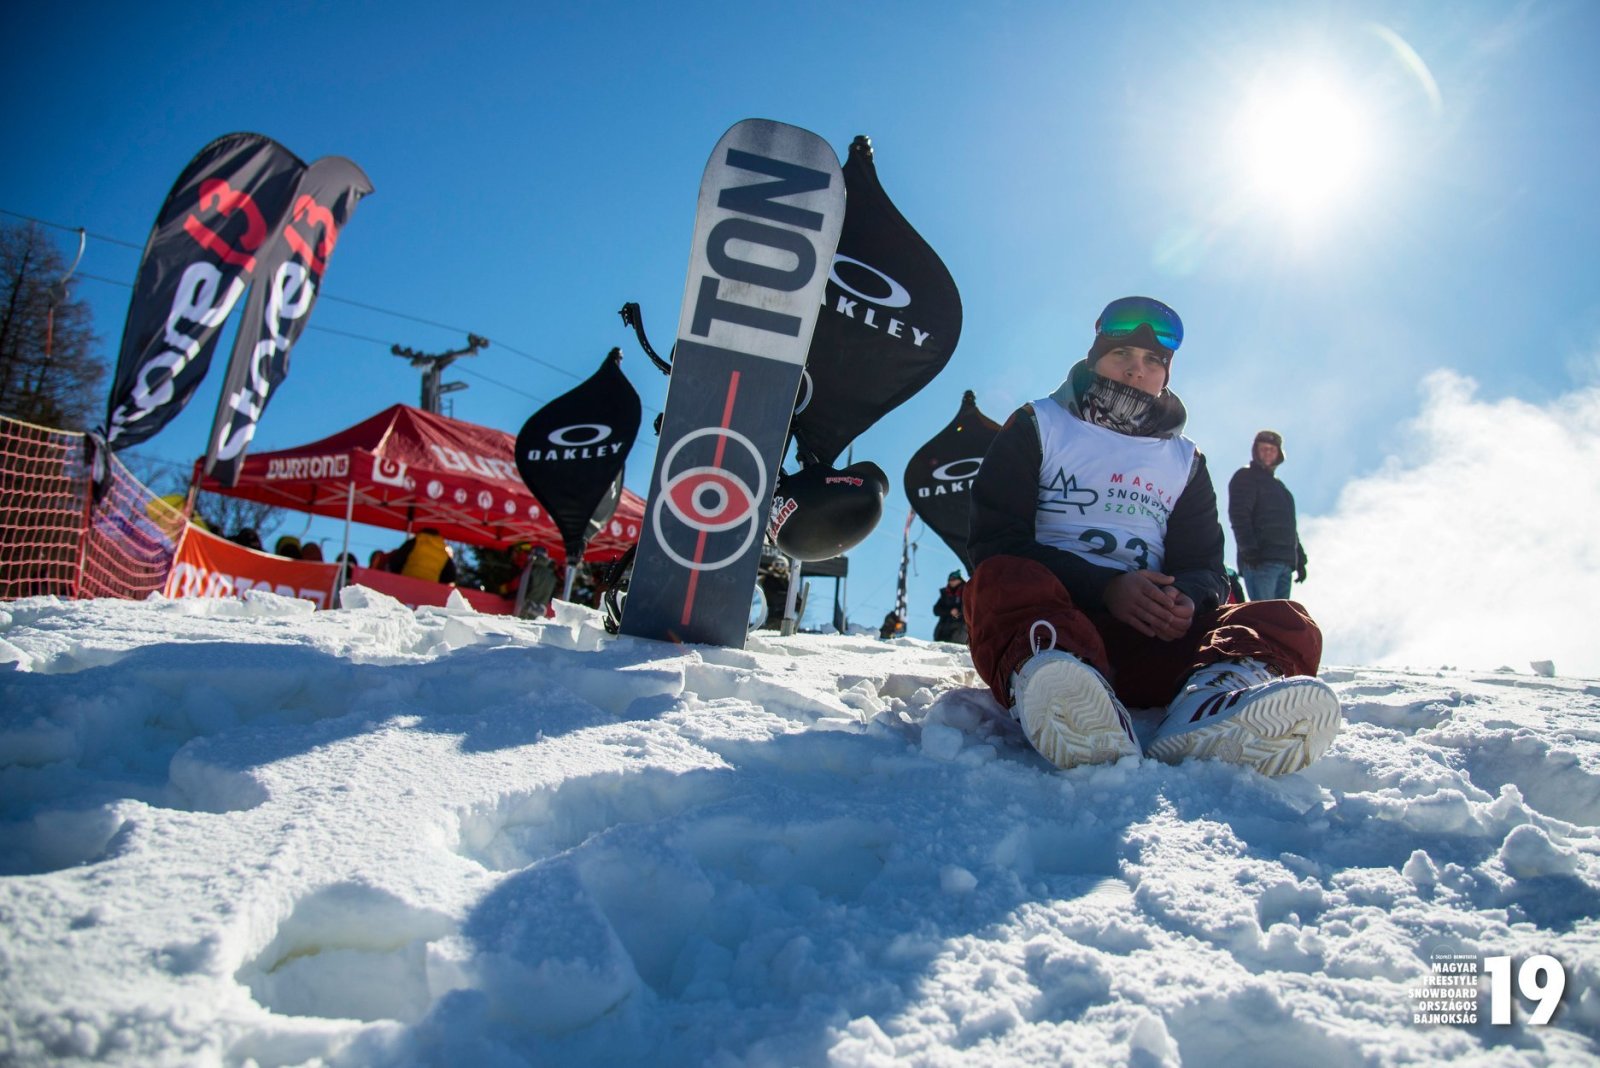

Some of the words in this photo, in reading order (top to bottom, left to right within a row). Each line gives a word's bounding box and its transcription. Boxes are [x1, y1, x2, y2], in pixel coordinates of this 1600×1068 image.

[690, 148, 832, 338] TON
[821, 290, 930, 347] KLEY
[266, 455, 336, 480] BURTON
[430, 444, 523, 483] BUR
[528, 442, 623, 461] OAKLEY
